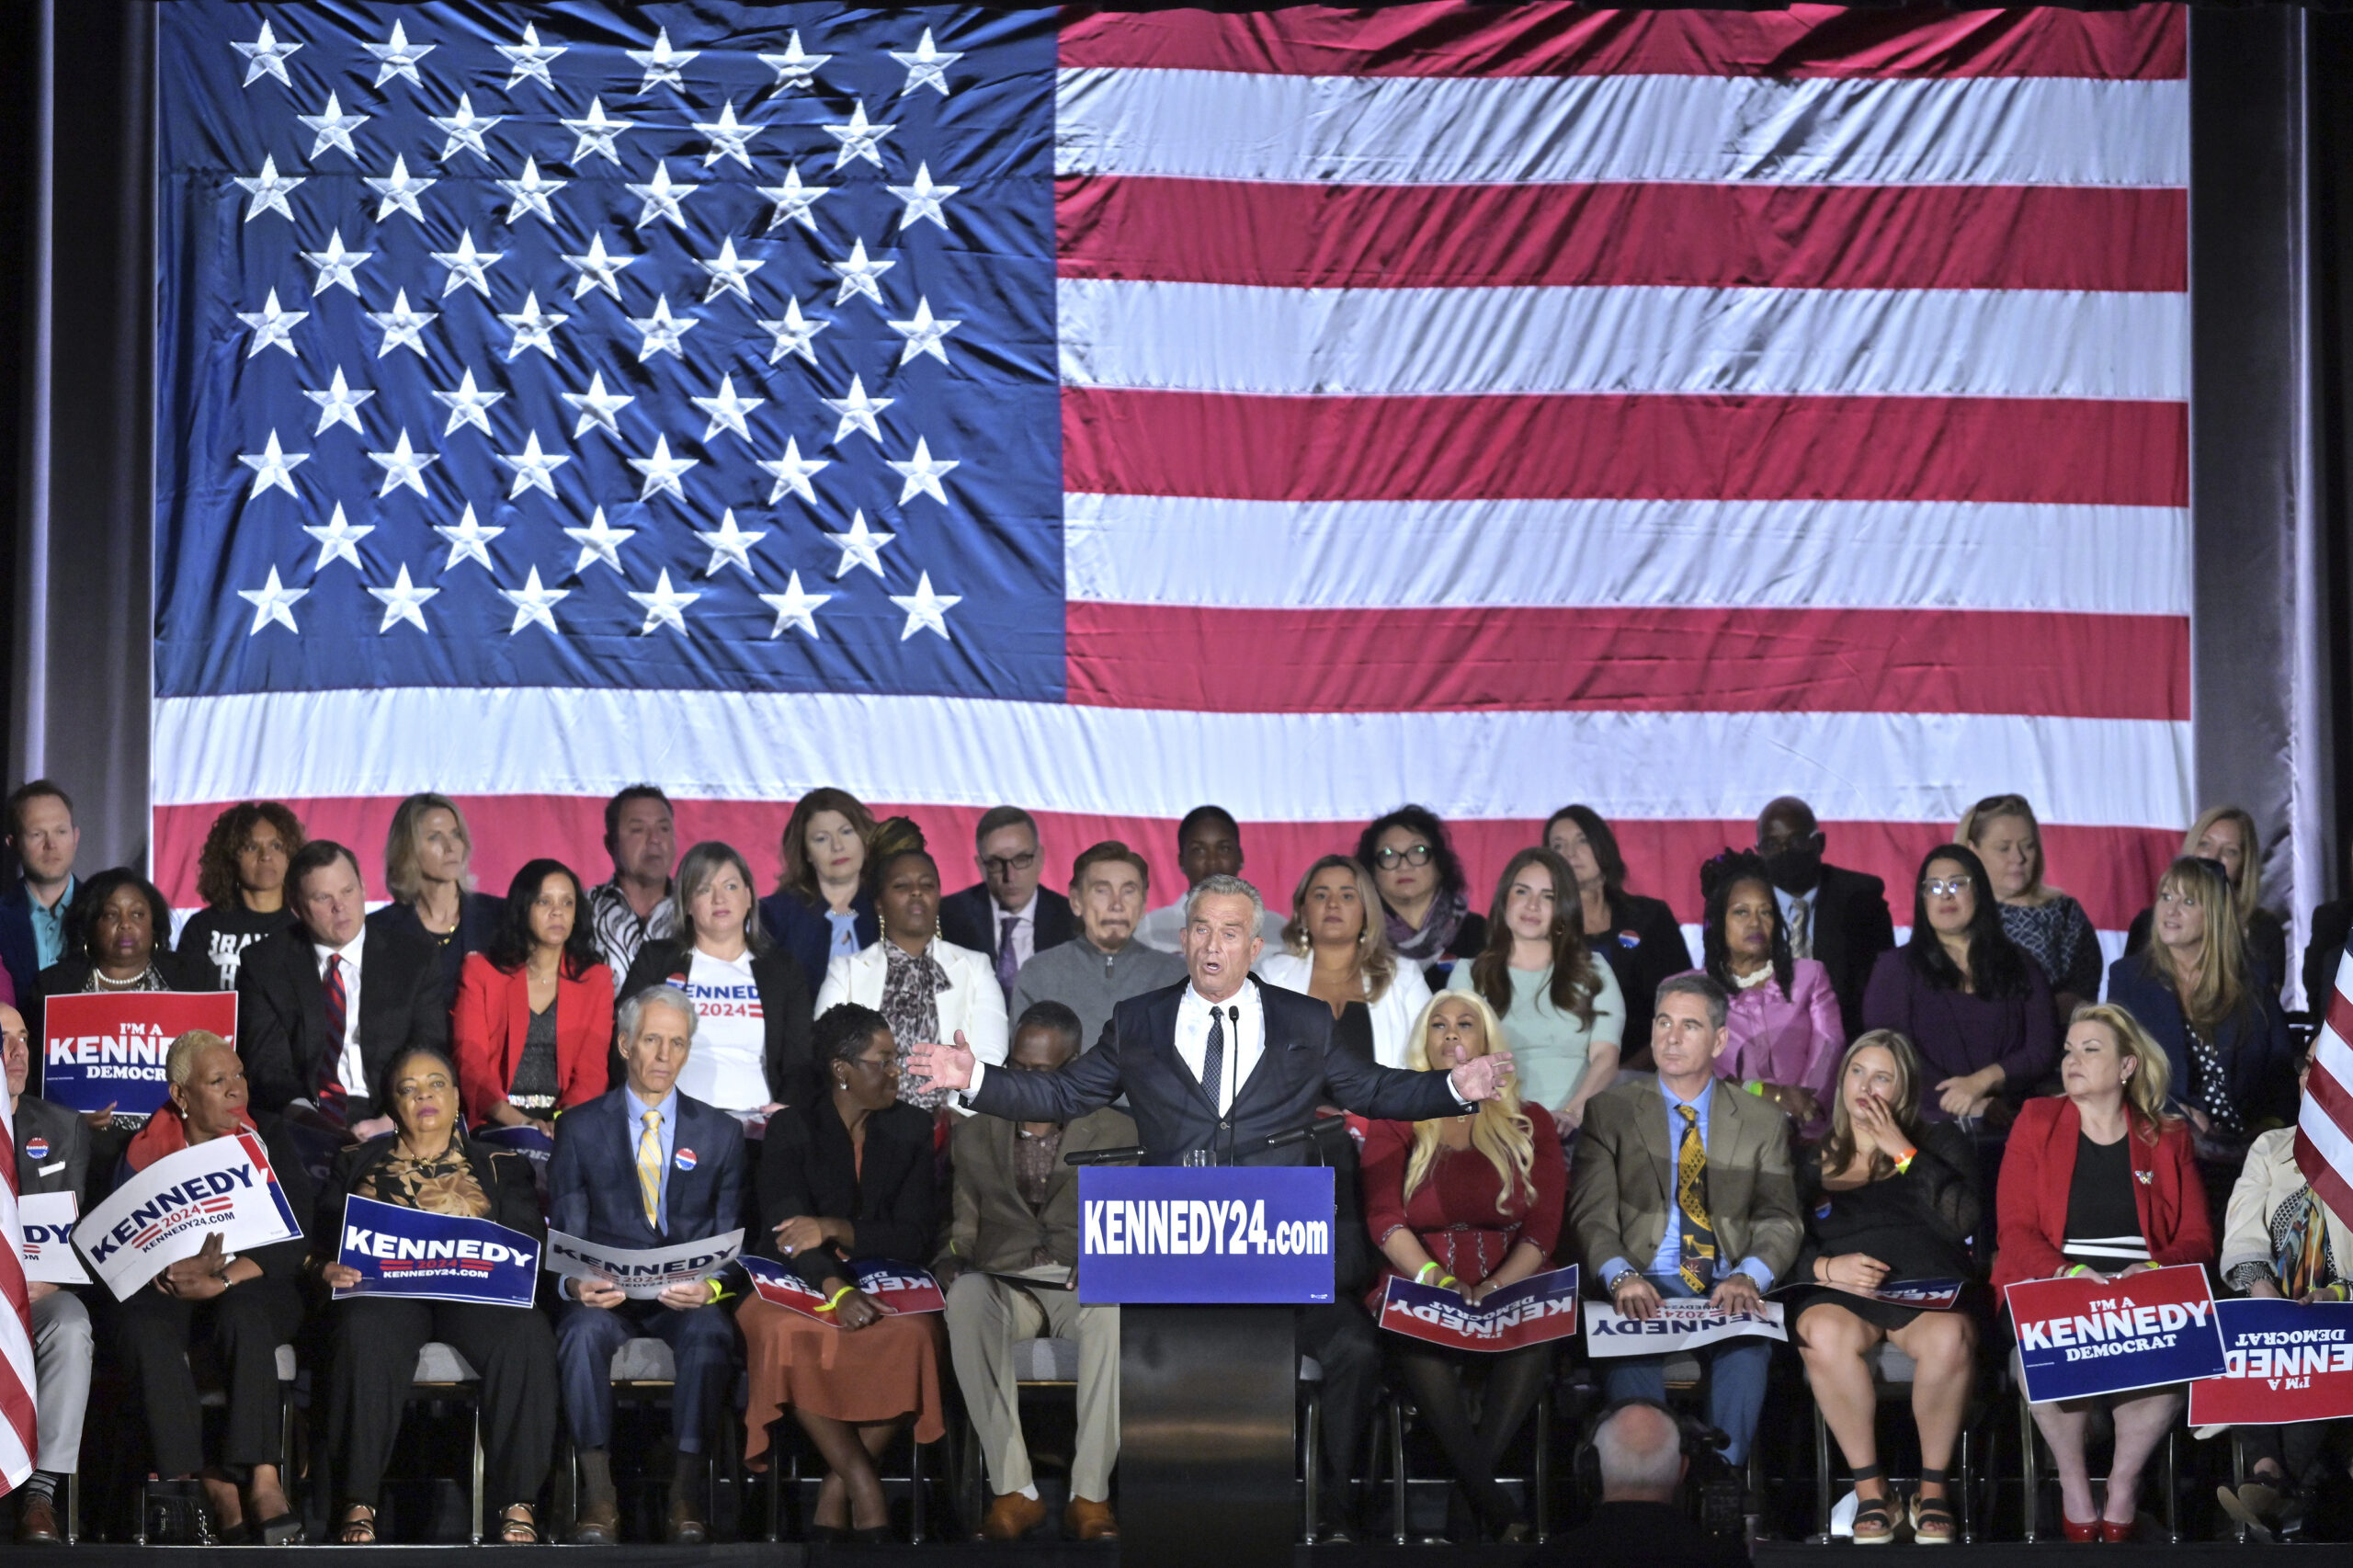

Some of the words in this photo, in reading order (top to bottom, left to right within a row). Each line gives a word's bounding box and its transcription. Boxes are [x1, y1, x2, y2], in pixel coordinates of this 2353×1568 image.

[687, 984, 761, 1000] ENNED
[699, 1003, 747, 1017] 2024
[119, 1023, 145, 1035] I'M
[150, 1023, 164, 1036] A
[50, 1035, 233, 1066] KENN
[86, 1066, 168, 1082] DEMOCR
[90, 1164, 254, 1265] KENNEDY
[162, 1205, 201, 1229] 2024
[142, 1211, 236, 1254] KENNEDY24.COM
[1084, 1199, 1329, 1256] KENNEDY24.com
[345, 1225, 534, 1267] KENNEDY
[416, 1259, 458, 1269] 2024
[553, 1244, 737, 1277] KENNEDY
[382, 1269, 489, 1279] KENNEDY24.COM
[623, 1275, 664, 1283] 2024
[1388, 1296, 1573, 1335] KENNEDY
[1428, 1295, 1536, 1322] DEMOCRAT
[1665, 1310, 1707, 1319] 2024
[2089, 1297, 2117, 1313] I'M
[2121, 1297, 2136, 1309] A
[2020, 1300, 2210, 1351] KENNEDY
[2064, 1334, 2177, 1362] DEMOCRAT
[2235, 1329, 2347, 1347] DEMOCRAT
[2213, 1343, 2353, 1379] ENNED
[2267, 1379, 2281, 1392] A
[2285, 1376, 2311, 1391] I'M
